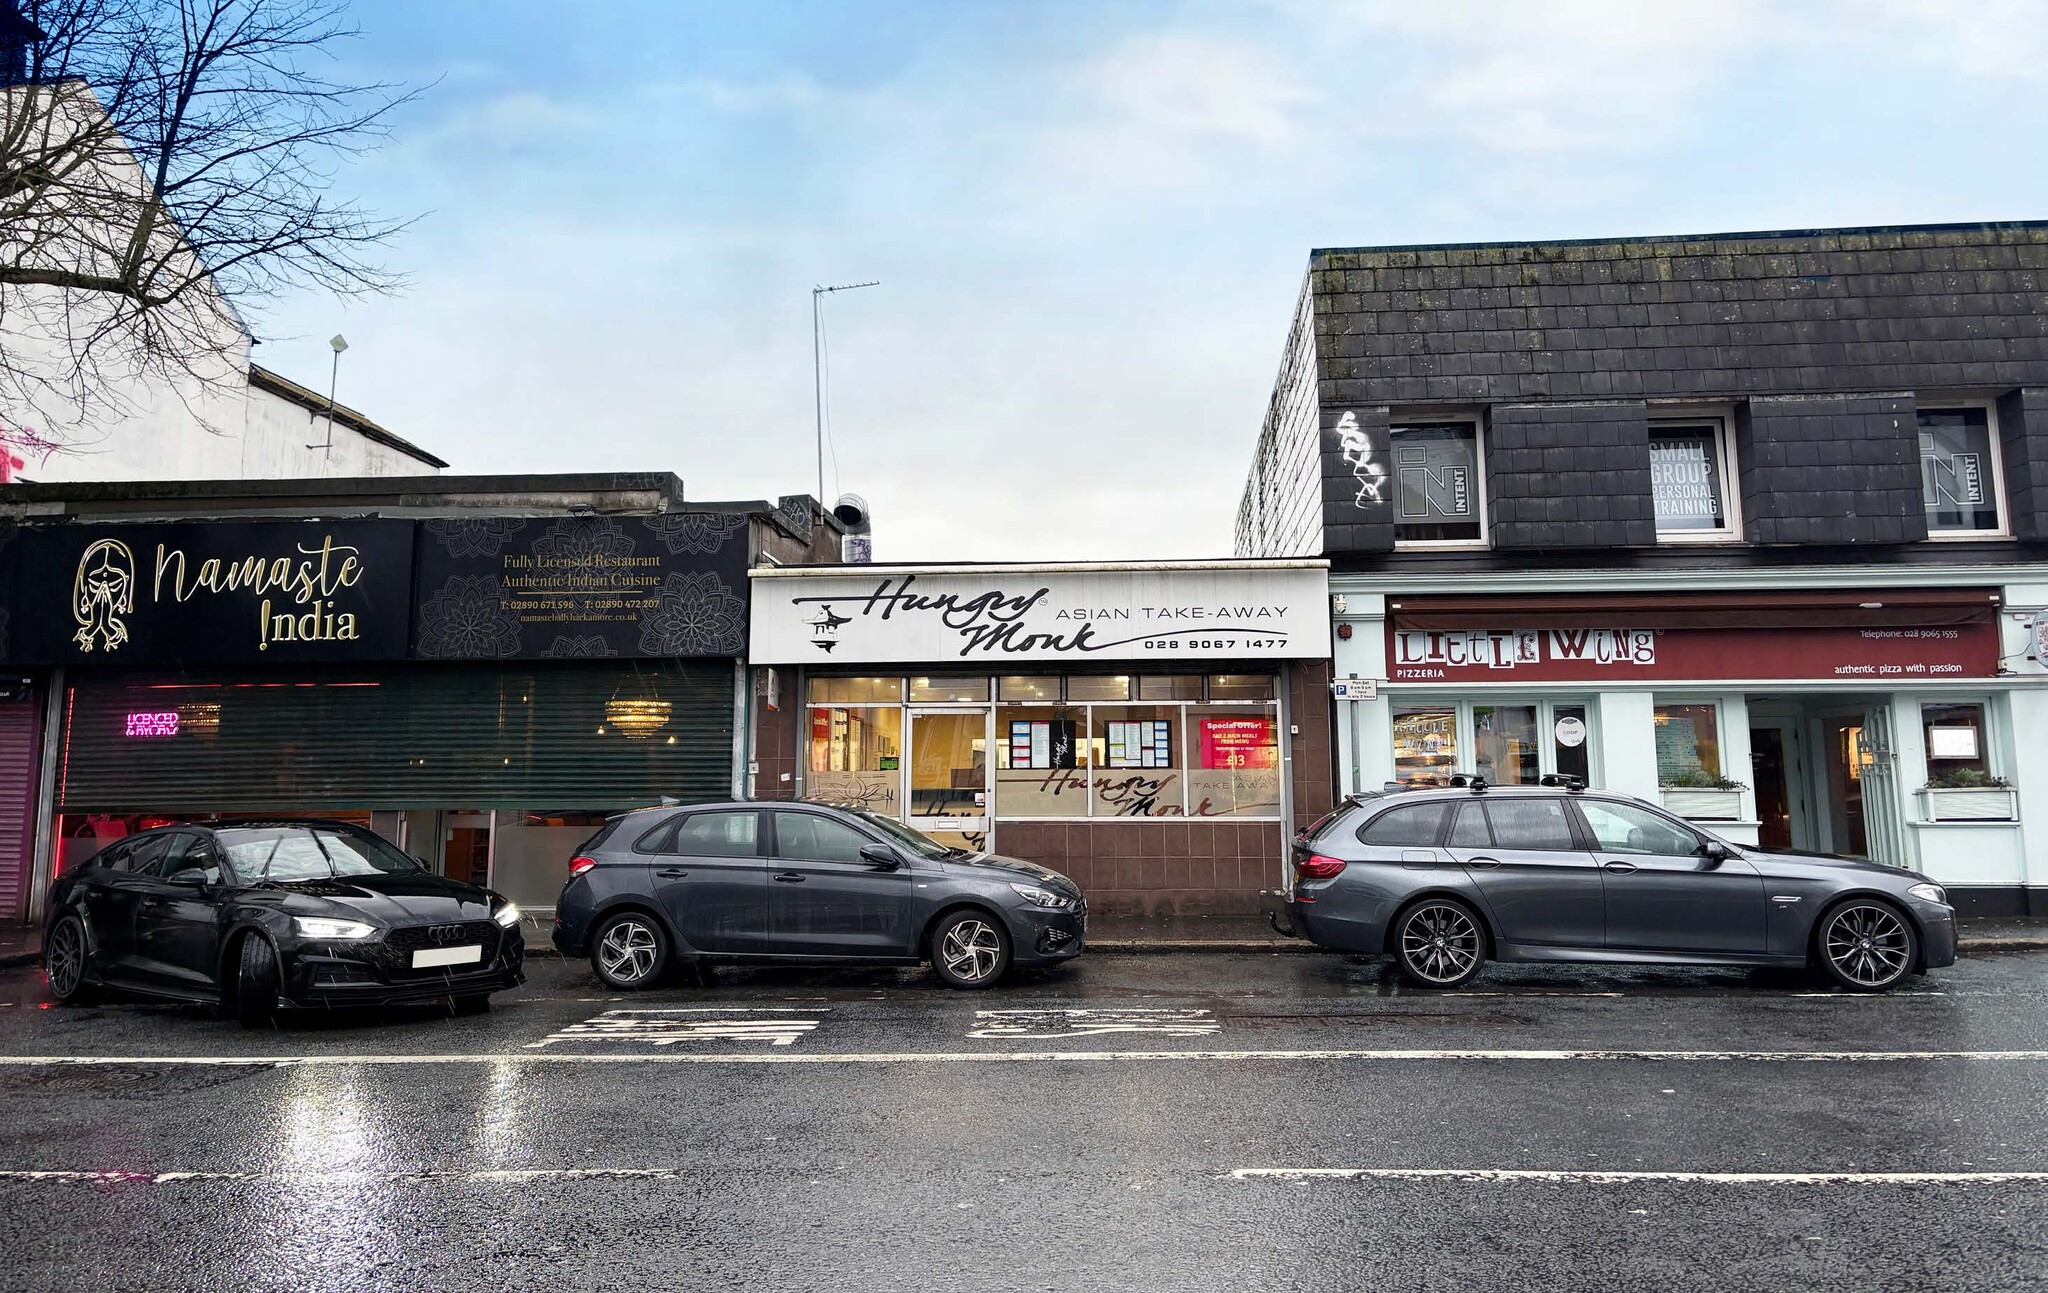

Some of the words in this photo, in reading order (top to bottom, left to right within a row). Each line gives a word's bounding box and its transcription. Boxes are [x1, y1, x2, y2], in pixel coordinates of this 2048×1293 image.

[1649, 441, 1710, 461] SMALL
[1650, 463, 1712, 484] GROUP
[1964, 456, 1980, 501] INTENT
[1454, 469, 1466, 512] INTENT
[1652, 484, 1716, 499] PERSONAL
[1653, 499, 1718, 515] TRAINING
[154, 534, 364, 604] Namaste
[504, 554, 533, 571] Fully
[537, 554, 592, 568] Licensed
[595, 554, 661, 567] Restaurant
[501, 574, 564, 588] Authentic
[568, 573, 607, 587] Indian
[611, 573, 661, 586] Cuisine
[500, 601, 509, 610] T:
[511, 601, 538, 609] 02890
[540, 601, 556, 609] 671
[557, 601, 574, 609] 596
[585, 600, 594, 608] T:
[595, 600, 623, 608] 02890
[625, 600, 641, 608] 472
[643, 600, 659, 608] 207
[792, 575, 1049, 629] Hungry
[1056, 608, 1130, 620] ASIAN
[1141, 606, 1289, 619] TAKE-AWAY
[259, 599, 360, 651] India
[960, 621, 1112, 657] Monk
[1860, 630, 1903, 640] Telephone:
[1904, 630, 1919, 638] 028
[1920, 630, 1940, 639] 9065
[1942, 630, 1958, 639] 1555
[1144, 640, 1179, 649] 028
[1189, 640, 1236, 649] 9067
[1246, 639, 1289, 648] 1477
[1396, 669, 1444, 678] PIZZERIA
[1834, 664, 1876, 674] authentic
[1879, 664, 1902, 675] pizza
[1905, 663, 1926, 673] with
[1930, 663, 1962, 674] passion
[127, 712, 179, 725] LICENCED
[1207, 721, 1235, 731] Special
[1236, 721, 1262, 730] Offer!
[1227, 754, 1245, 766] £13
[997, 768, 1178, 801] Hungry
[1194, 782, 1230, 790] TAKE
